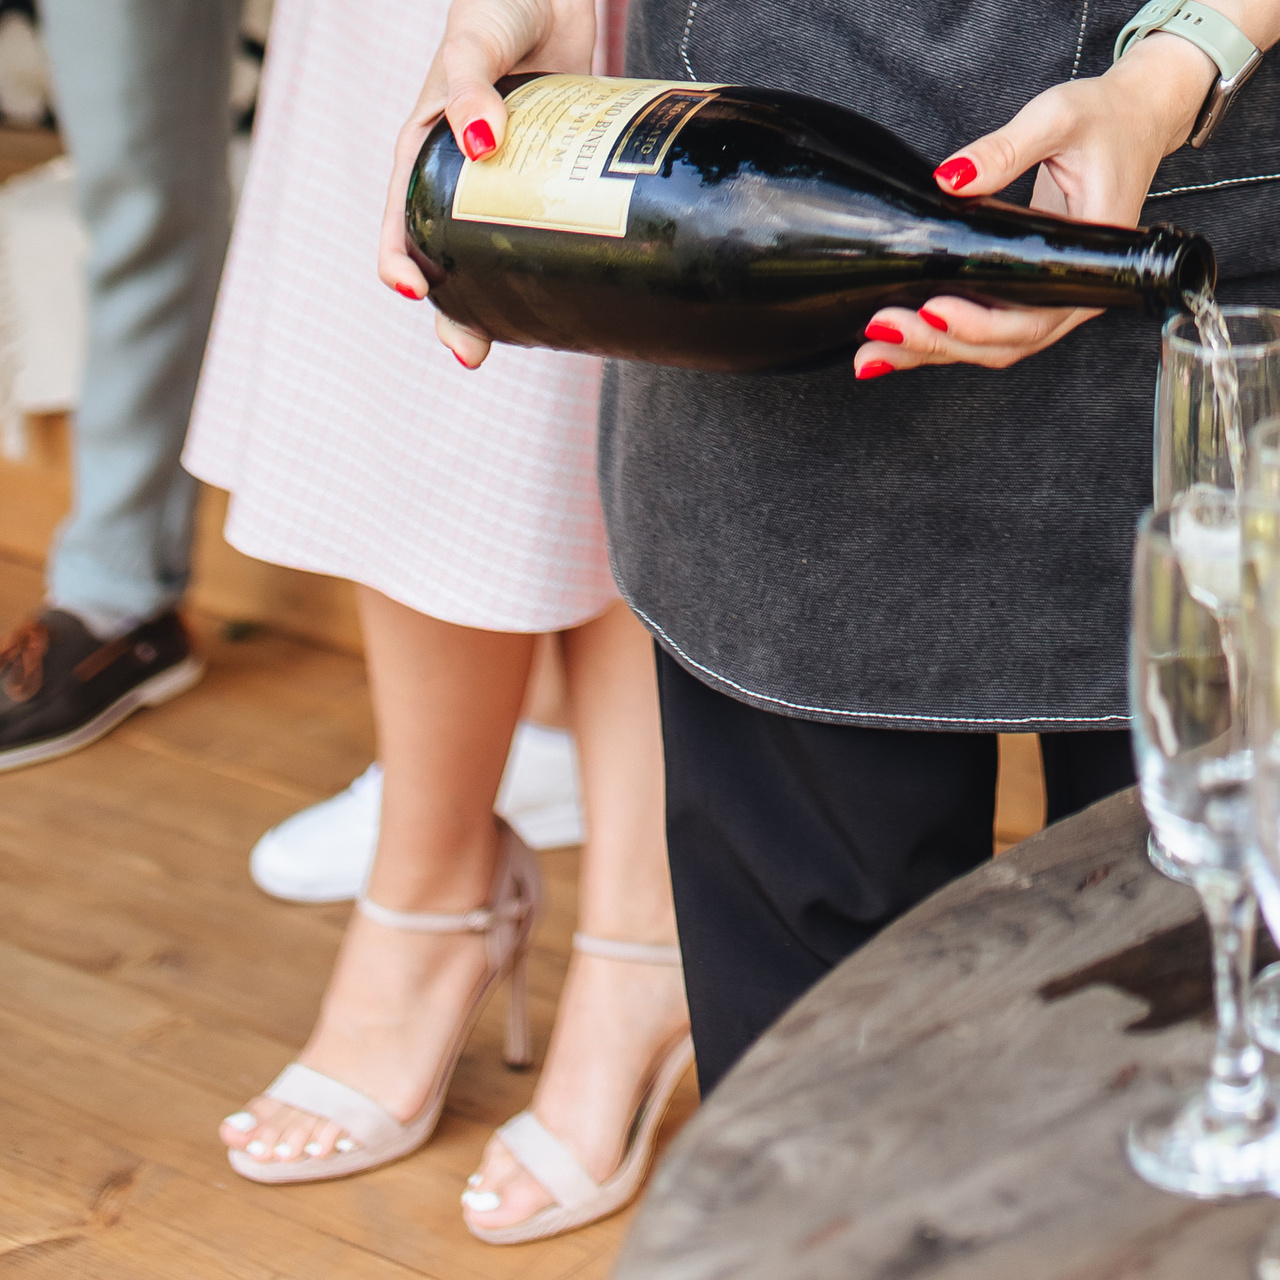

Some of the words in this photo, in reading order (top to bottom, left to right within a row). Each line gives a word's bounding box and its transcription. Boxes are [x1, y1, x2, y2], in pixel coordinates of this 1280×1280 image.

[552, 87, 621, 163] PREMIUM
[604, 83, 662, 117] MASTRO
[639, 100, 691, 155] MOSCATO
[568, 118, 613, 182] BINELLI
